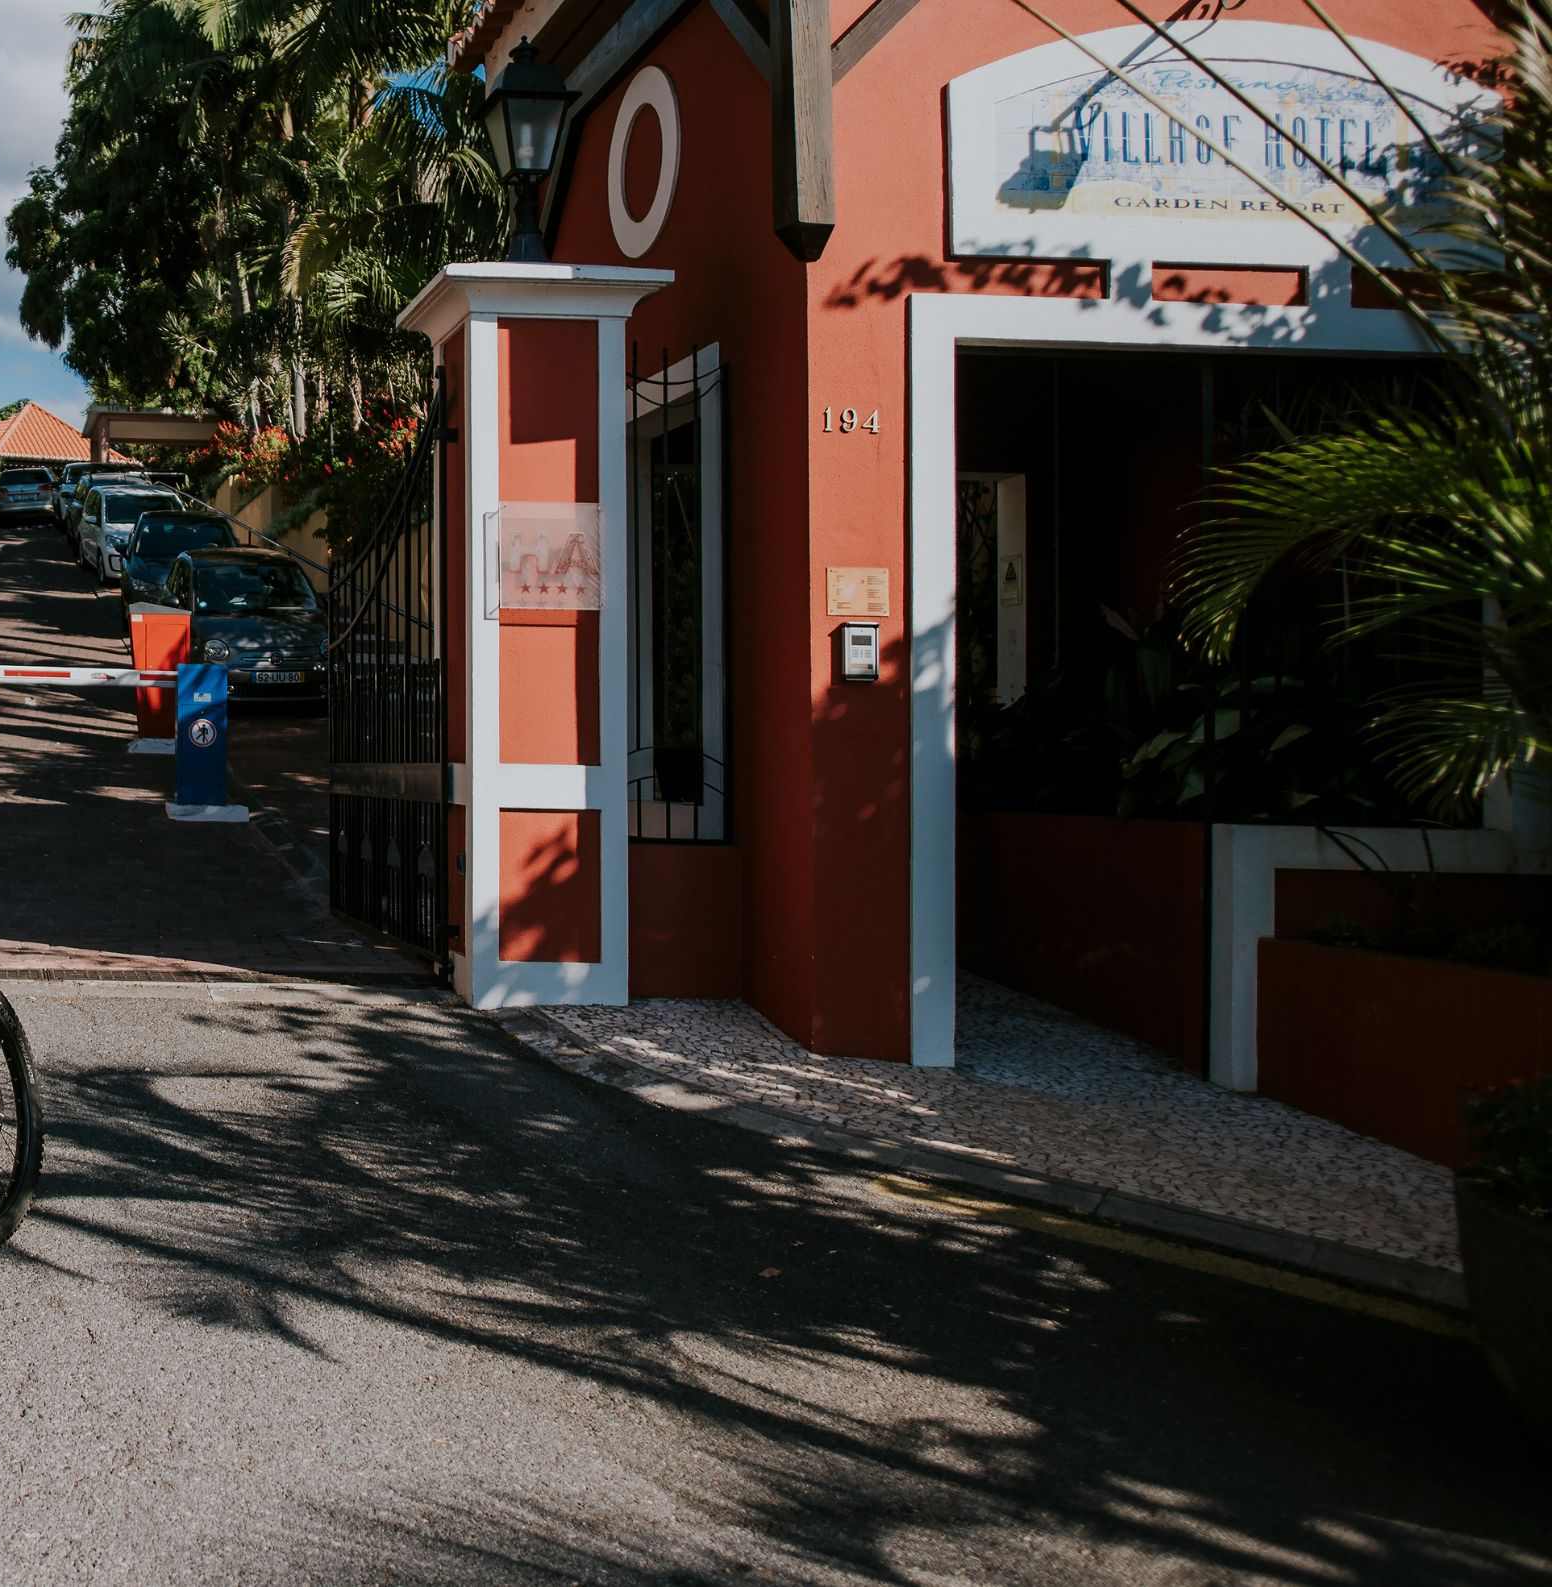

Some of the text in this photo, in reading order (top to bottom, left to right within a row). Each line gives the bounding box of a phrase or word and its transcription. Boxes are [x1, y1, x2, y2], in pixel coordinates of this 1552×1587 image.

[1074, 102, 1386, 174] VILLAGE HOTEL
[1114, 196, 1228, 210] GARDEN
[823, 406, 881, 434] 194
